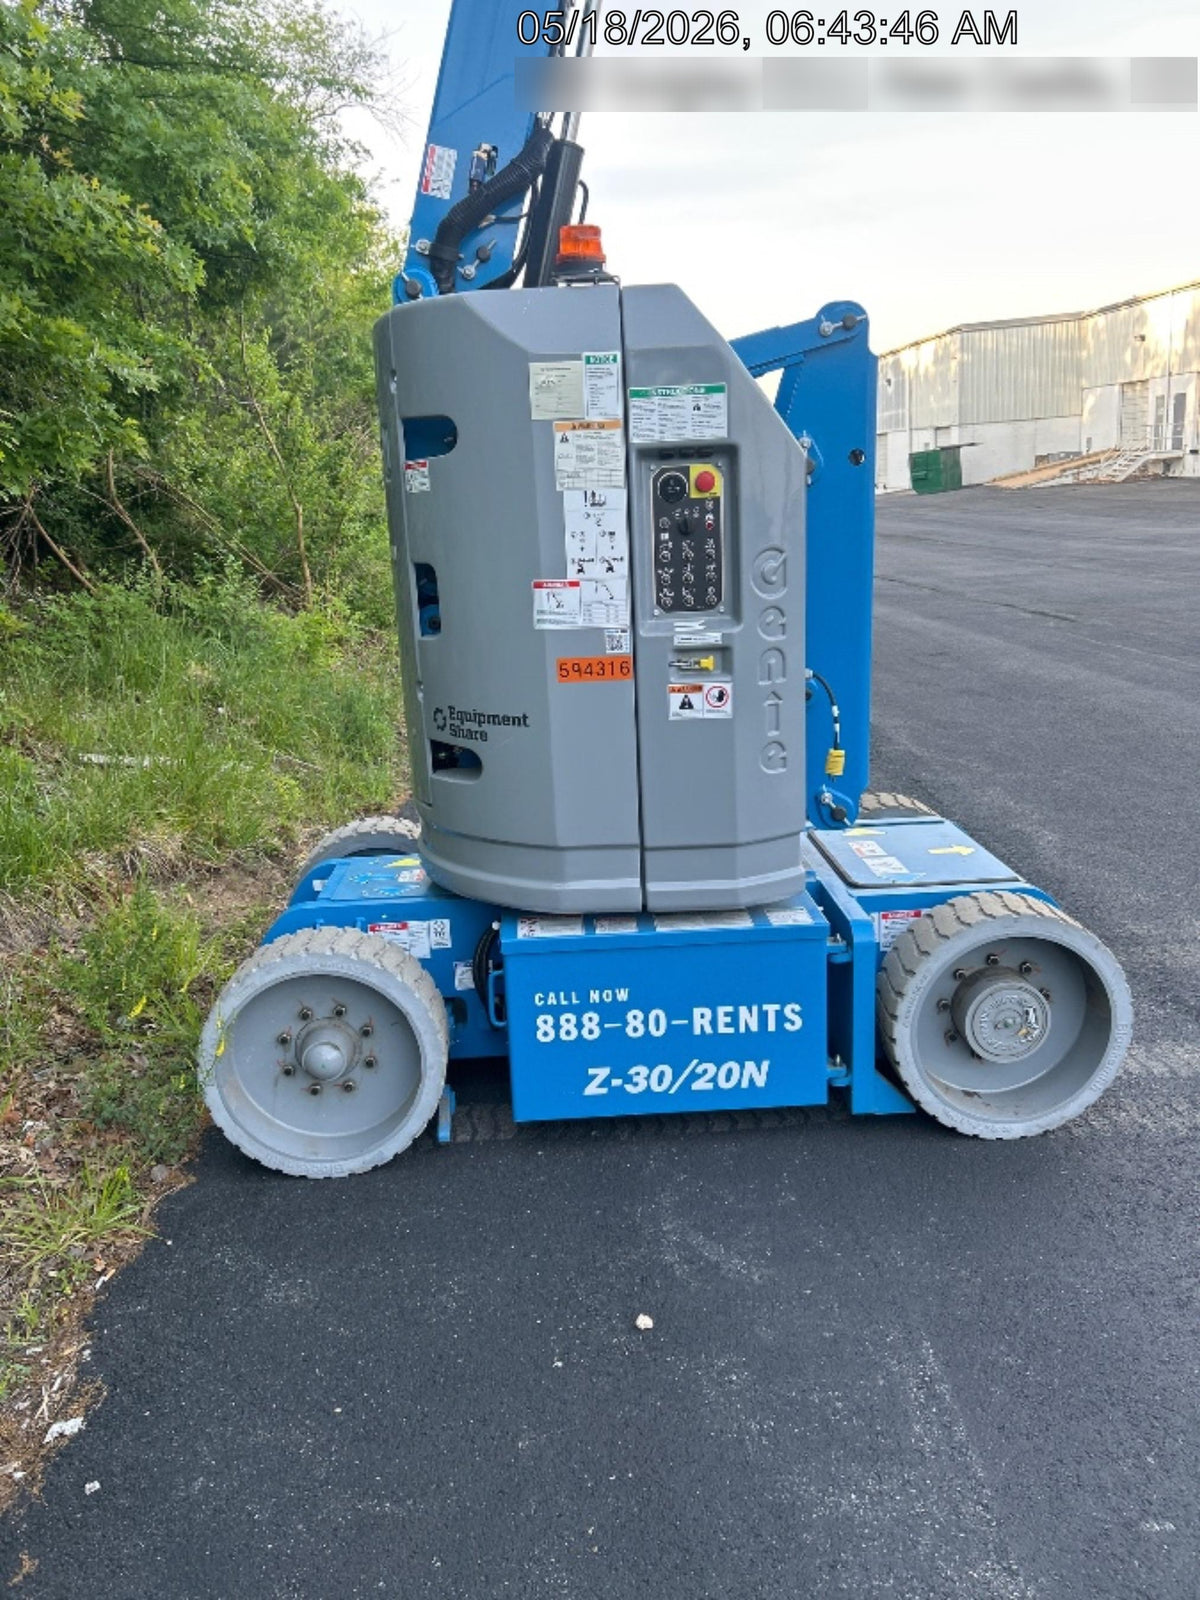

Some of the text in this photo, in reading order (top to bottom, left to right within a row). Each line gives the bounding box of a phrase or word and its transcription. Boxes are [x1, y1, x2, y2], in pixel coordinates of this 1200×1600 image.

[559, 660, 631, 679] 594316
[448, 705, 530, 727] Equipment
[448, 723, 489, 742] Share
[534, 988, 629, 1006] CALL NOW
[536, 1003, 803, 1043] 888-80-RENTS
[583, 1059, 770, 1096] Z-30/20N
